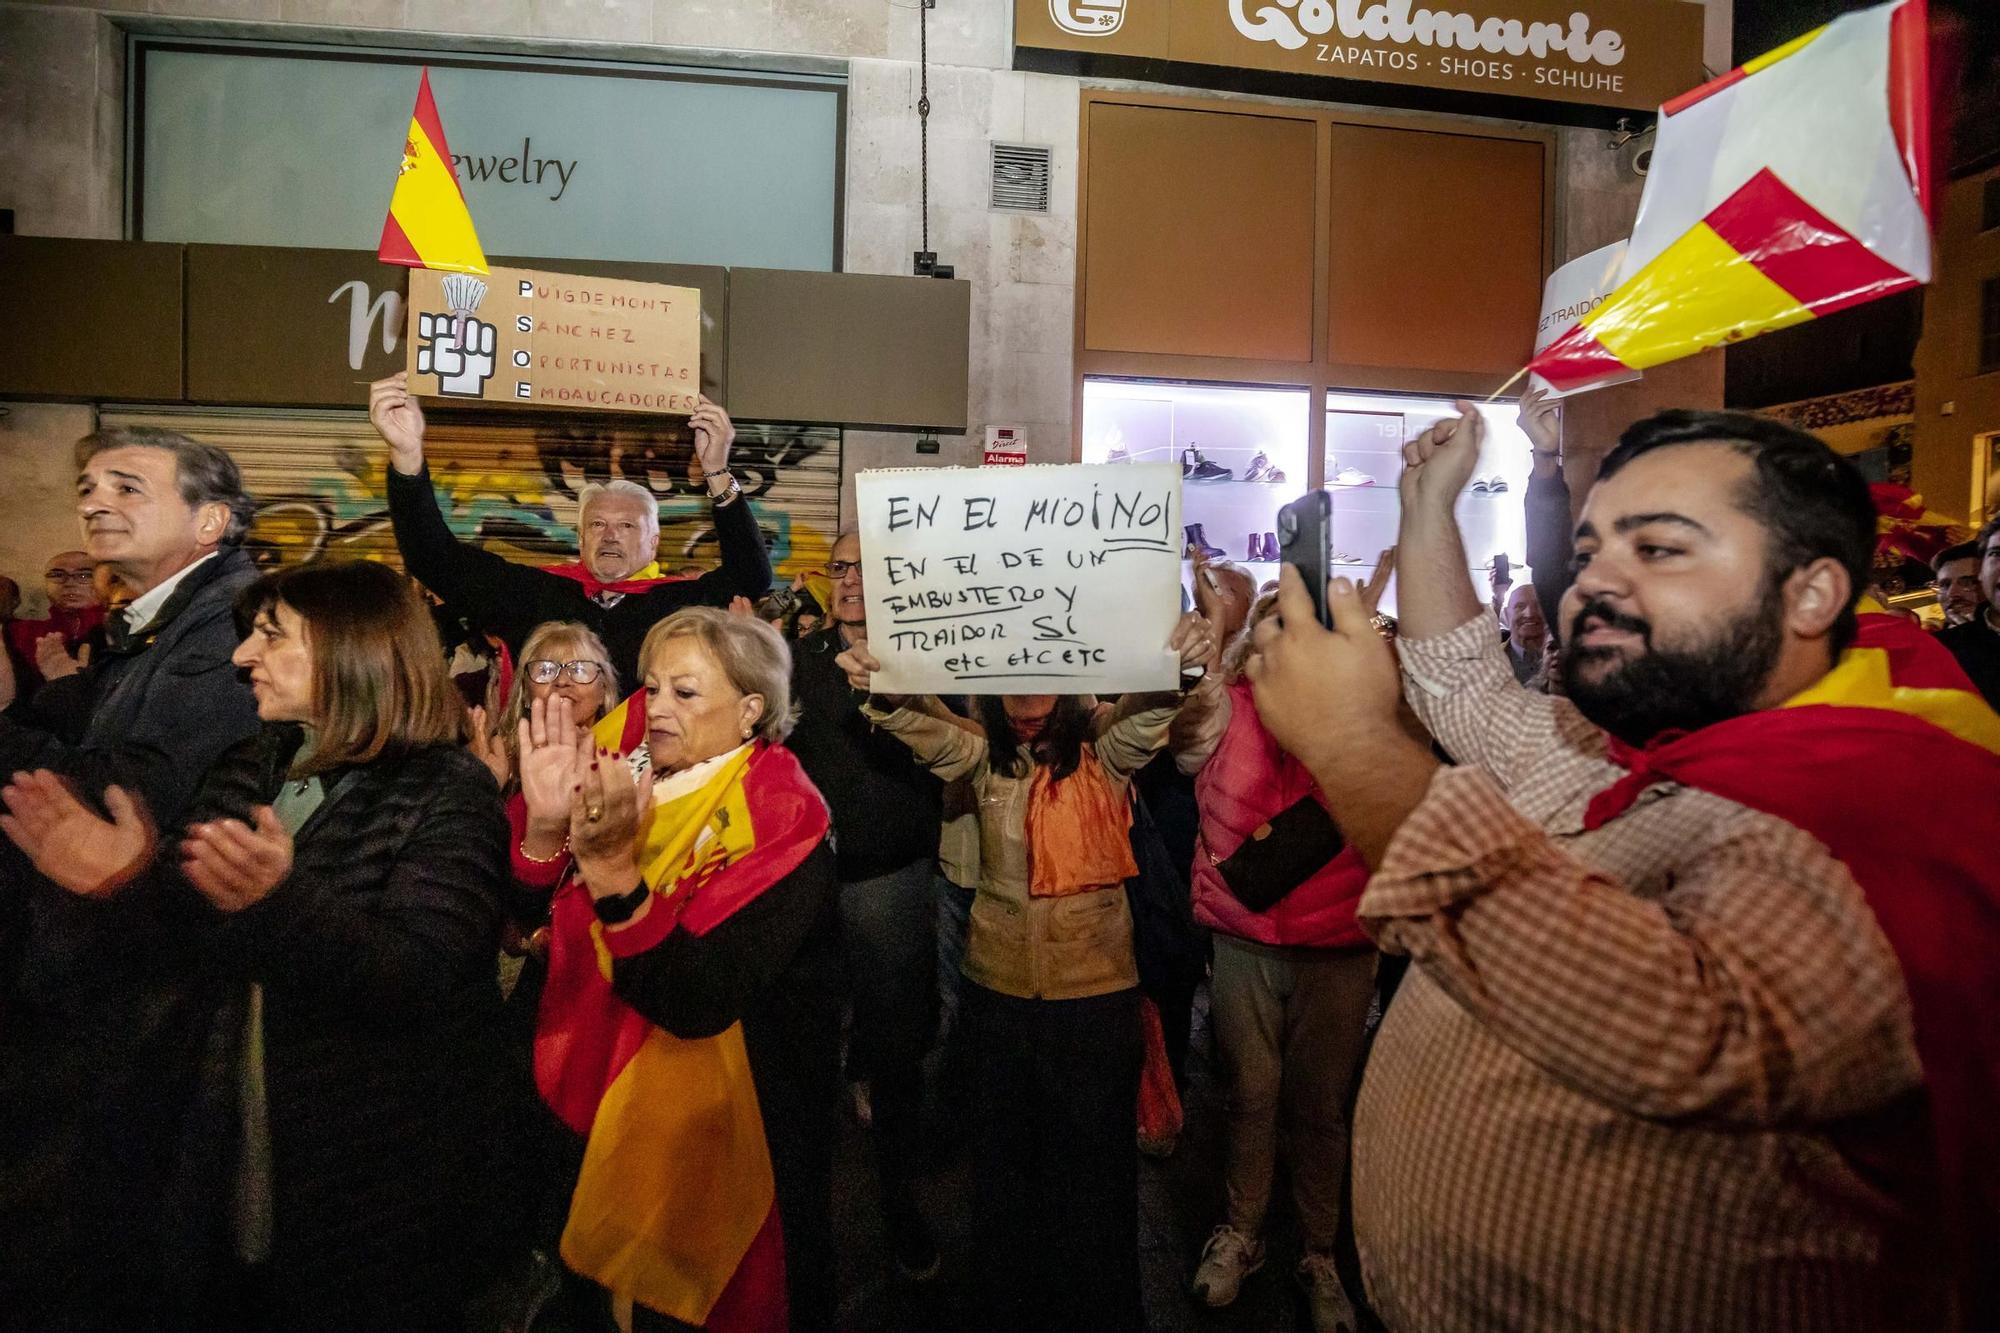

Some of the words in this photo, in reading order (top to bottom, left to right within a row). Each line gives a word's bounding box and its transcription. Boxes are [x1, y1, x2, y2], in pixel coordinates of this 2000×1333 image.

[1228, 0, 1625, 66] Goldmarie
[1316, 44, 1418, 71] ZAPATOS
[1440, 56, 1513, 80] SHOES
[1534, 67, 1624, 92] SCHUHE
[450, 137, 578, 201] ewelry
[517, 316, 635, 343] SANCHEZ
[987, 454, 1024, 463] Alarma
[888, 495, 940, 530] EN
[884, 557, 927, 585] EN
[1001, 548, 1044, 568] DE
[1067, 550, 1107, 568] UN
[883, 586, 1044, 615] EMBUSTERO
[1055, 586, 1077, 612] Y
[944, 652, 990, 672] etc
